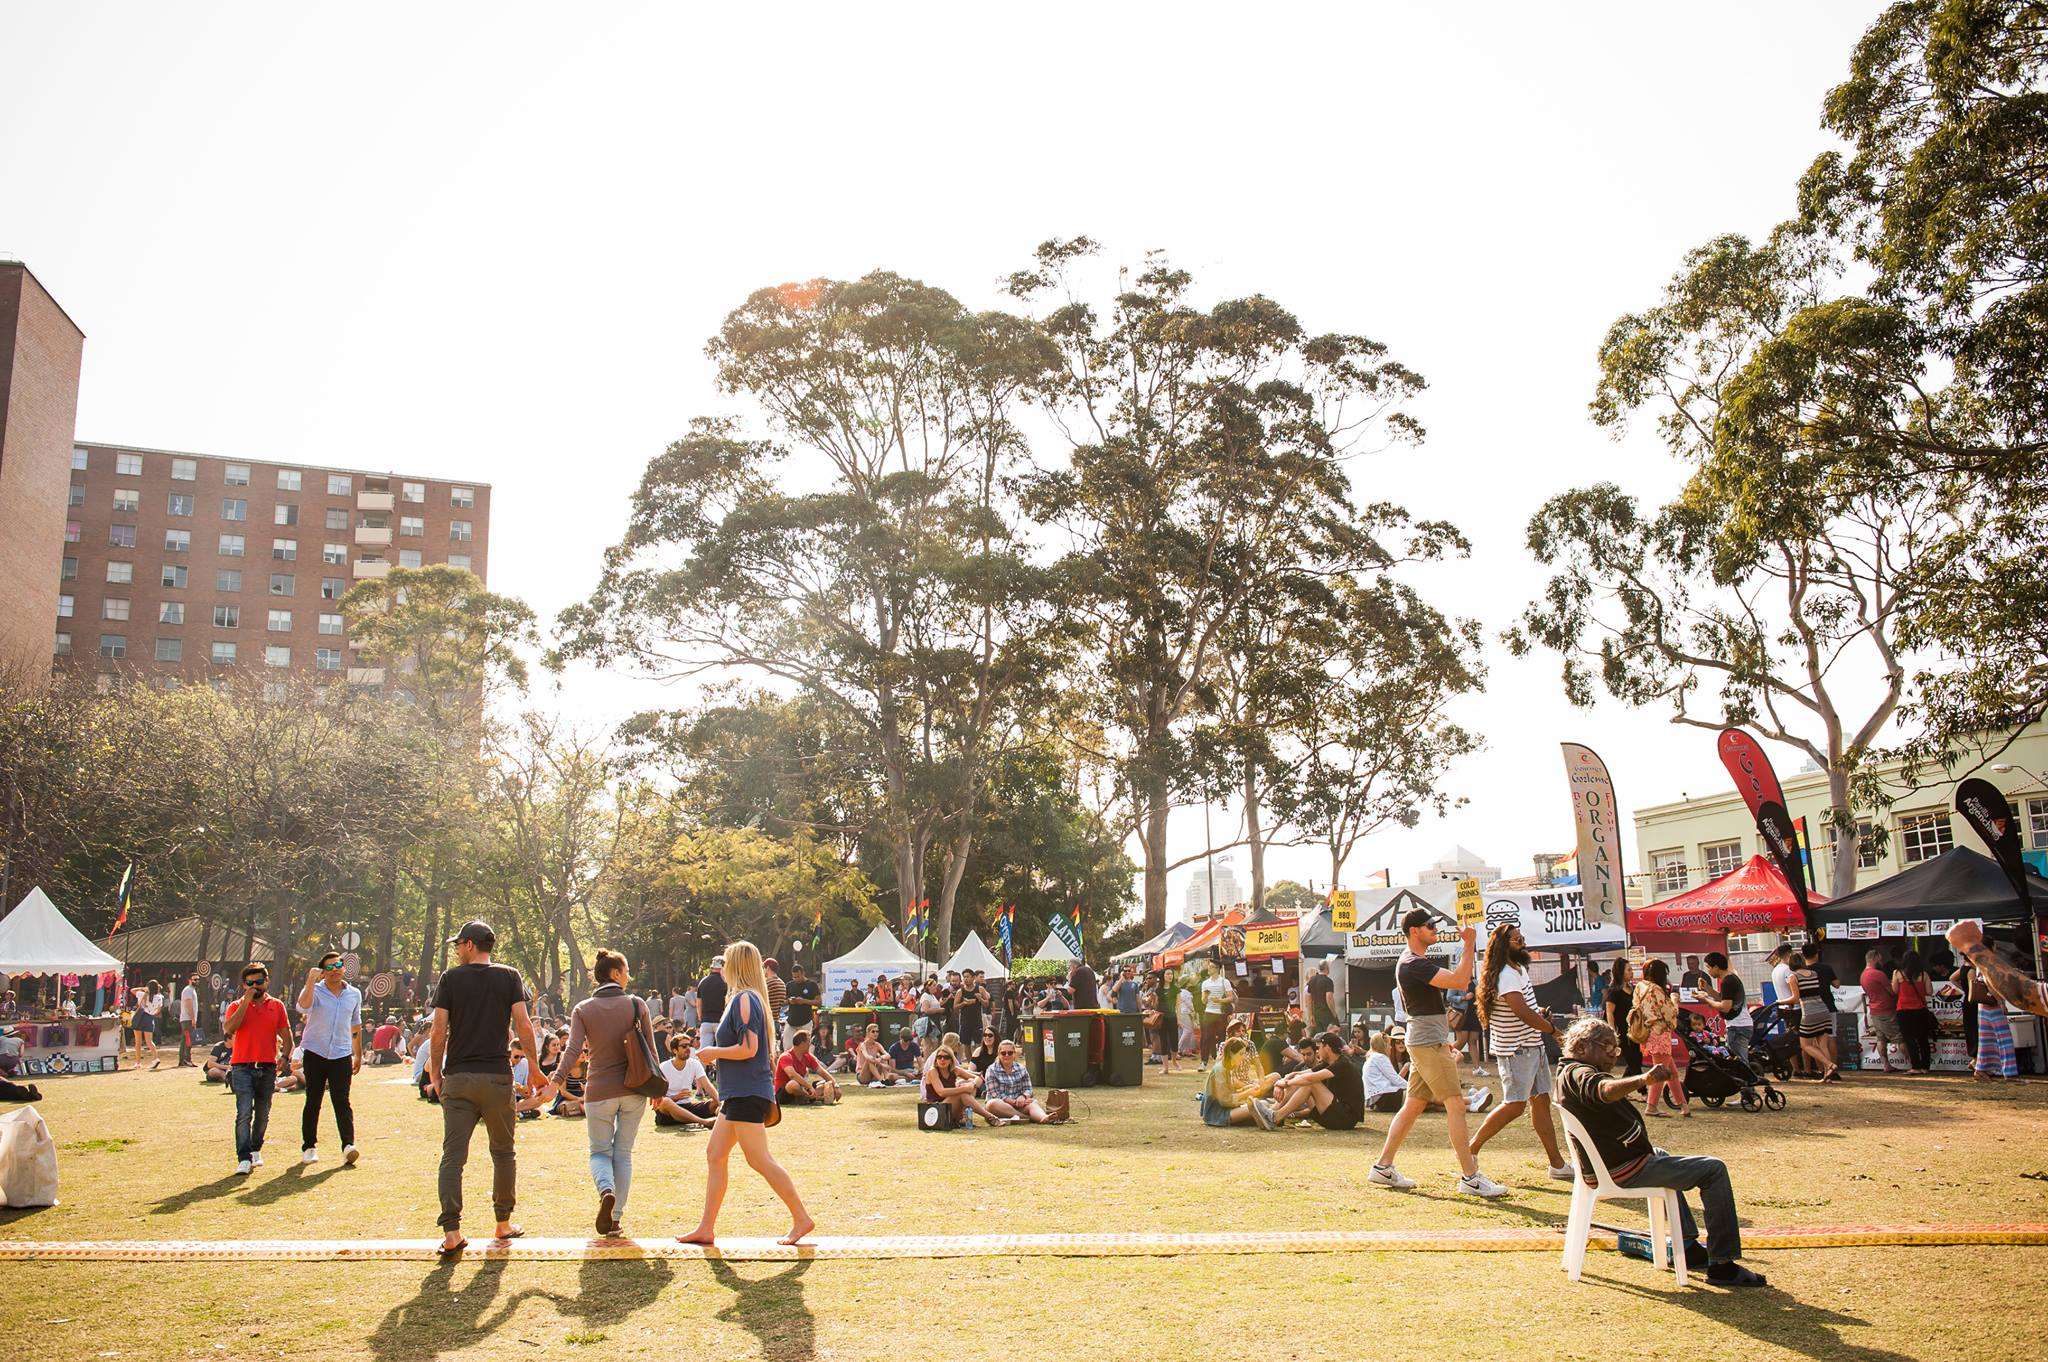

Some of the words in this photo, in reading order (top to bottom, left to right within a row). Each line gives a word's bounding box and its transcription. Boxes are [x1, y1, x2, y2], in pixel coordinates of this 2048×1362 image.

[1605, 793, 1614, 832] Flour
[1586, 790, 1614, 916] ORGANIC
[1460, 881, 1475, 890] COLD
[1457, 889, 1479, 898] DRINKS
[1463, 902, 1475, 911] BBQ
[1531, 894, 1564, 911] NEW
[1457, 911, 1484, 921] Brtwurst
[1656, 912, 1712, 929] Gourmet
[1715, 907, 1773, 925] Gozleme
[1333, 921, 1355, 930] Kransky
[1258, 931, 1283, 943] Paella
[1353, 933, 1371, 948] The
[1371, 930, 1407, 946] Sauerk
[1927, 998, 1963, 1009] chino
[1938, 1057, 1970, 1065] Americ
